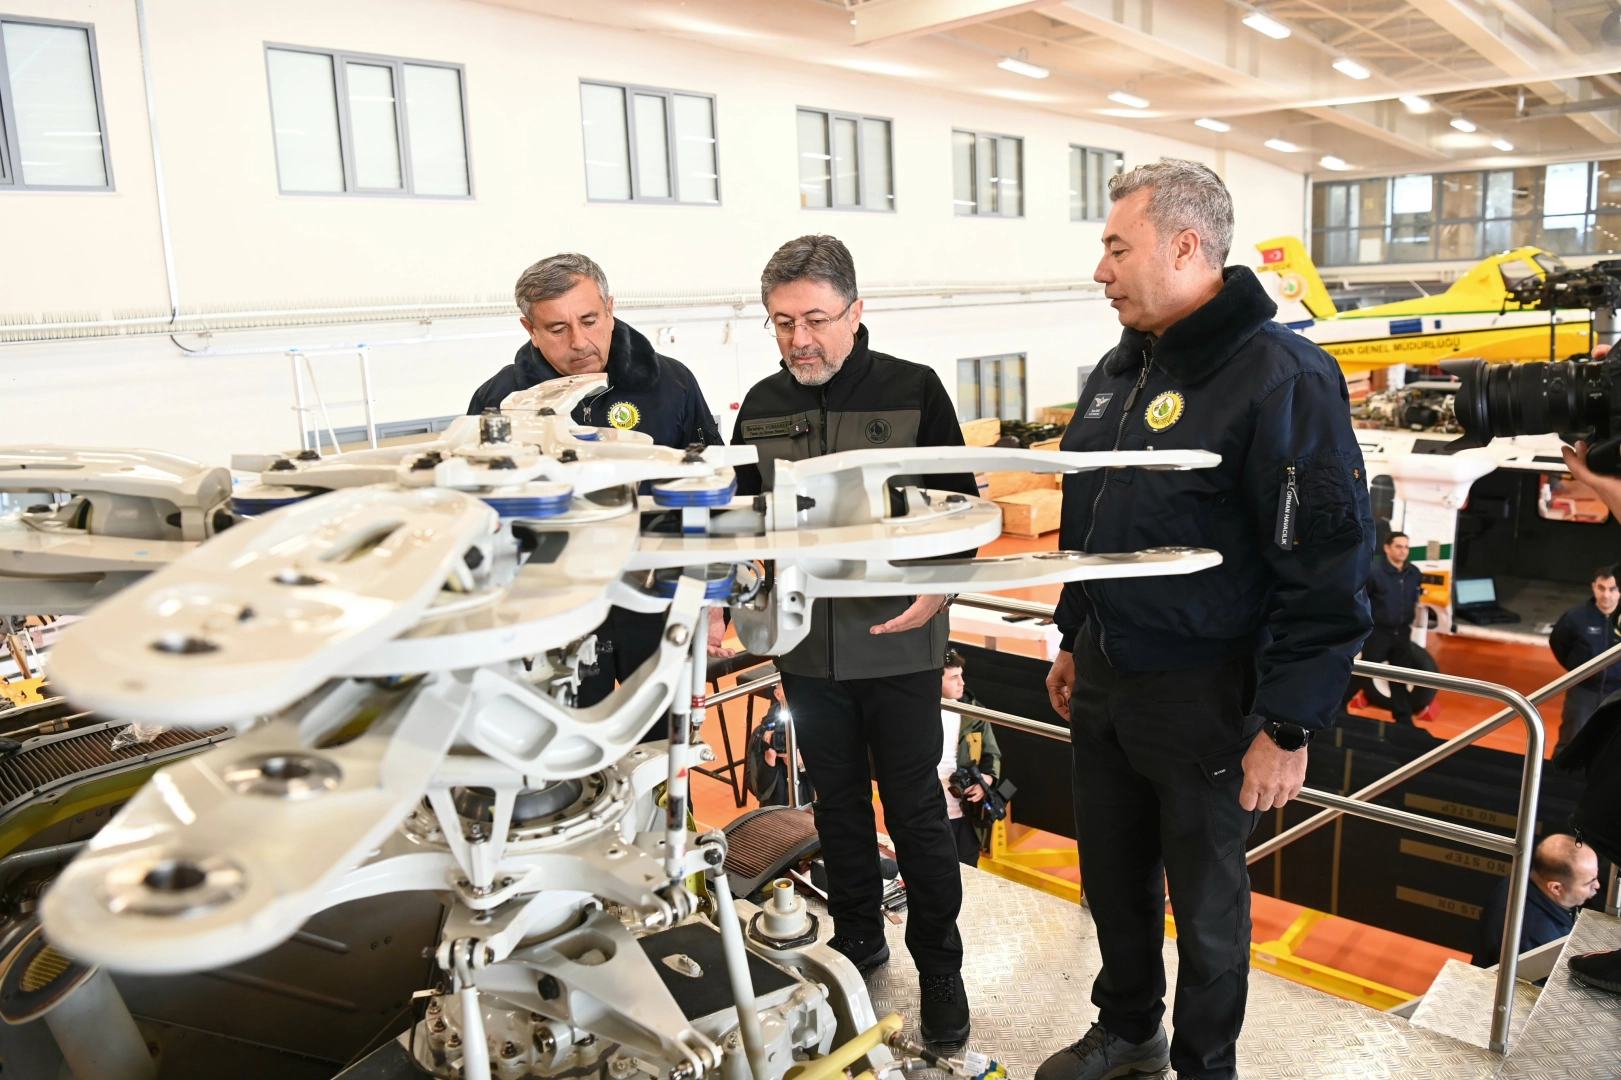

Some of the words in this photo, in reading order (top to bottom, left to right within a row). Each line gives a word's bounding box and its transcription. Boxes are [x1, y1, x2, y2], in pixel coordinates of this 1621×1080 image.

[1357, 345, 1389, 354] GENEL
[1284, 490, 1292, 513] ORMAN
[1281, 514, 1290, 544] HAVACILIK
[1441, 803, 1473, 818] STEP
[1479, 811, 1497, 823] NO
[1444, 851, 1480, 867] STEP
[1486, 860, 1506, 873] NO
[1438, 898, 1455, 911] NO
